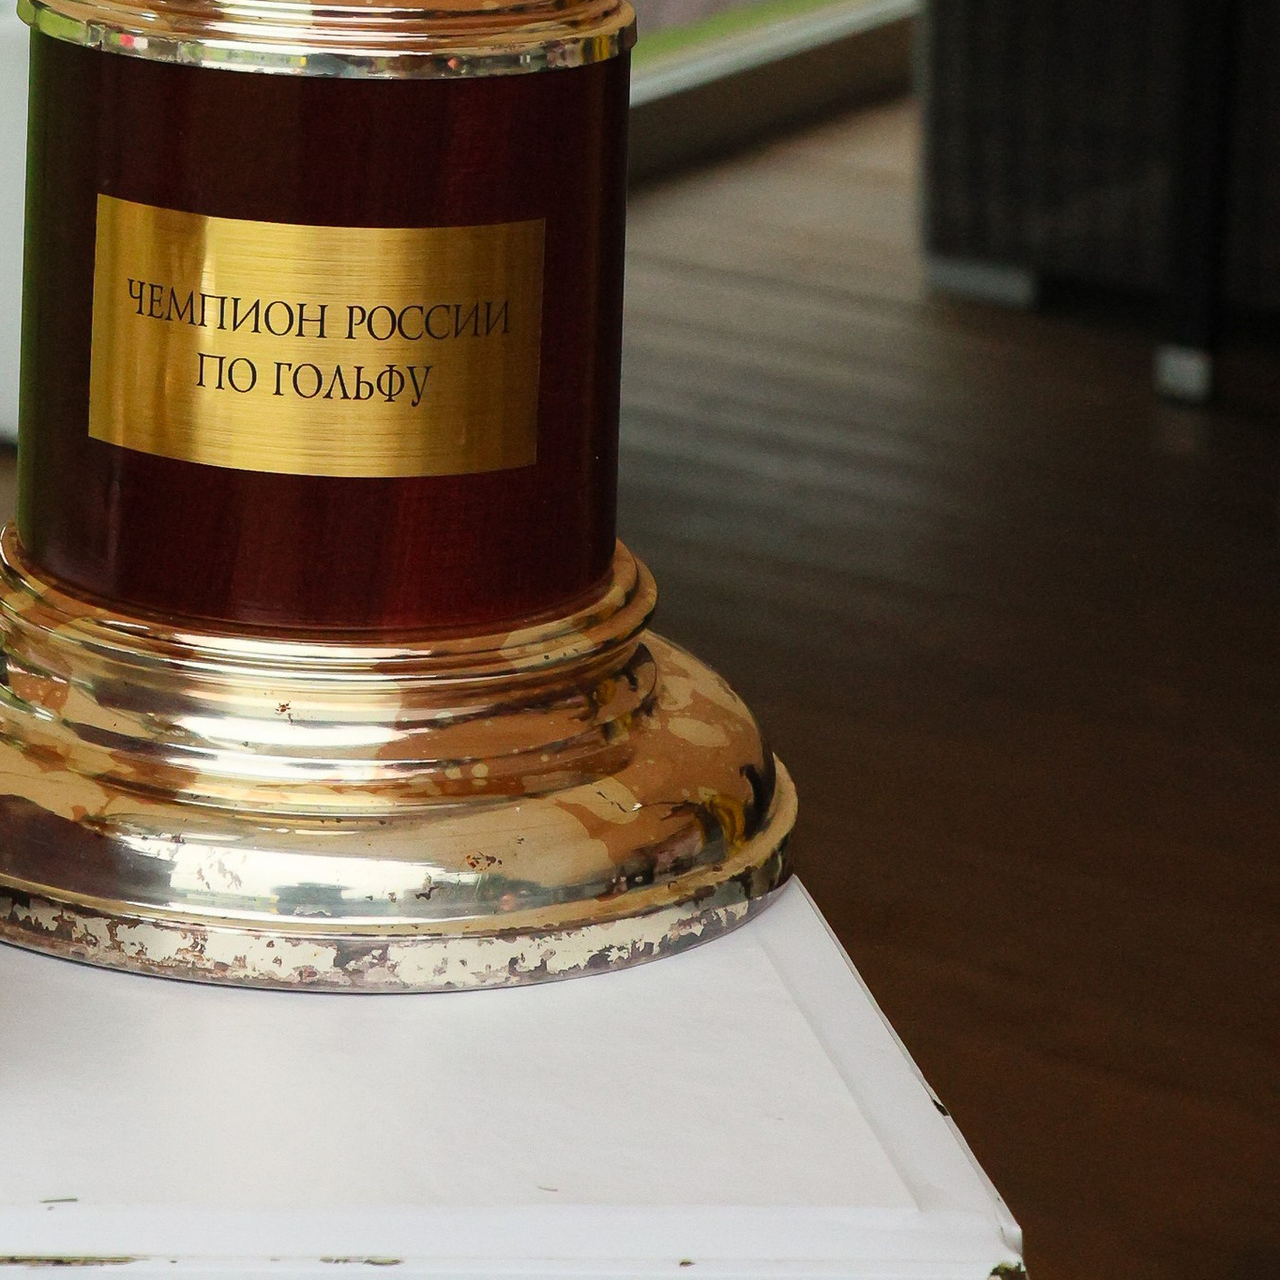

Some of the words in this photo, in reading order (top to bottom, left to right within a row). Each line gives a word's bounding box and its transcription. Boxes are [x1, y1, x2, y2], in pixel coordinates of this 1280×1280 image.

[127, 278, 328, 339] ЧЕМПИОН
[345, 300, 510, 341] РОССИИ
[196, 352, 258, 394] ПО
[273, 363, 433, 407] ГОЛЬФУ
